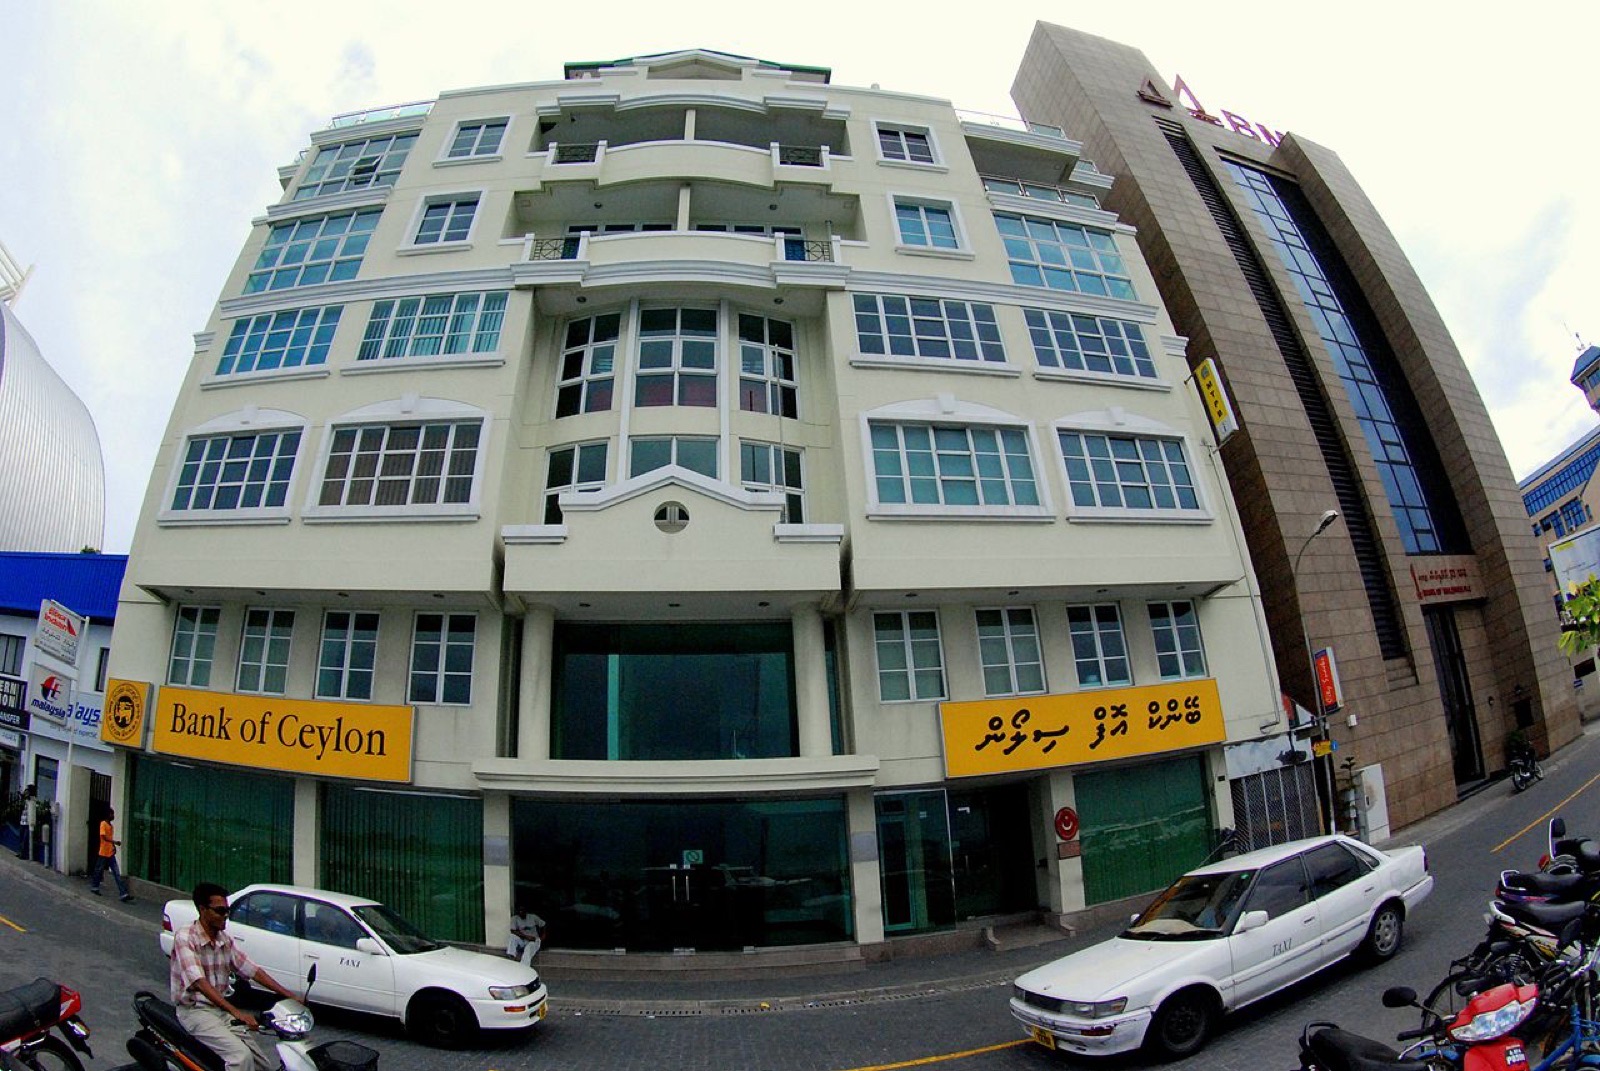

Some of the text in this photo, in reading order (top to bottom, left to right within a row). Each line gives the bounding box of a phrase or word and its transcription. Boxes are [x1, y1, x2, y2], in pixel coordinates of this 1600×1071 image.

[31, 699, 66, 718] malaysia
[170, 703, 232, 741] Bank
[240, 711, 272, 745] of
[278, 714, 387, 761] Ceylon
[1272, 937, 1292, 956] TAXI
[339, 957, 361, 968] TAXI
